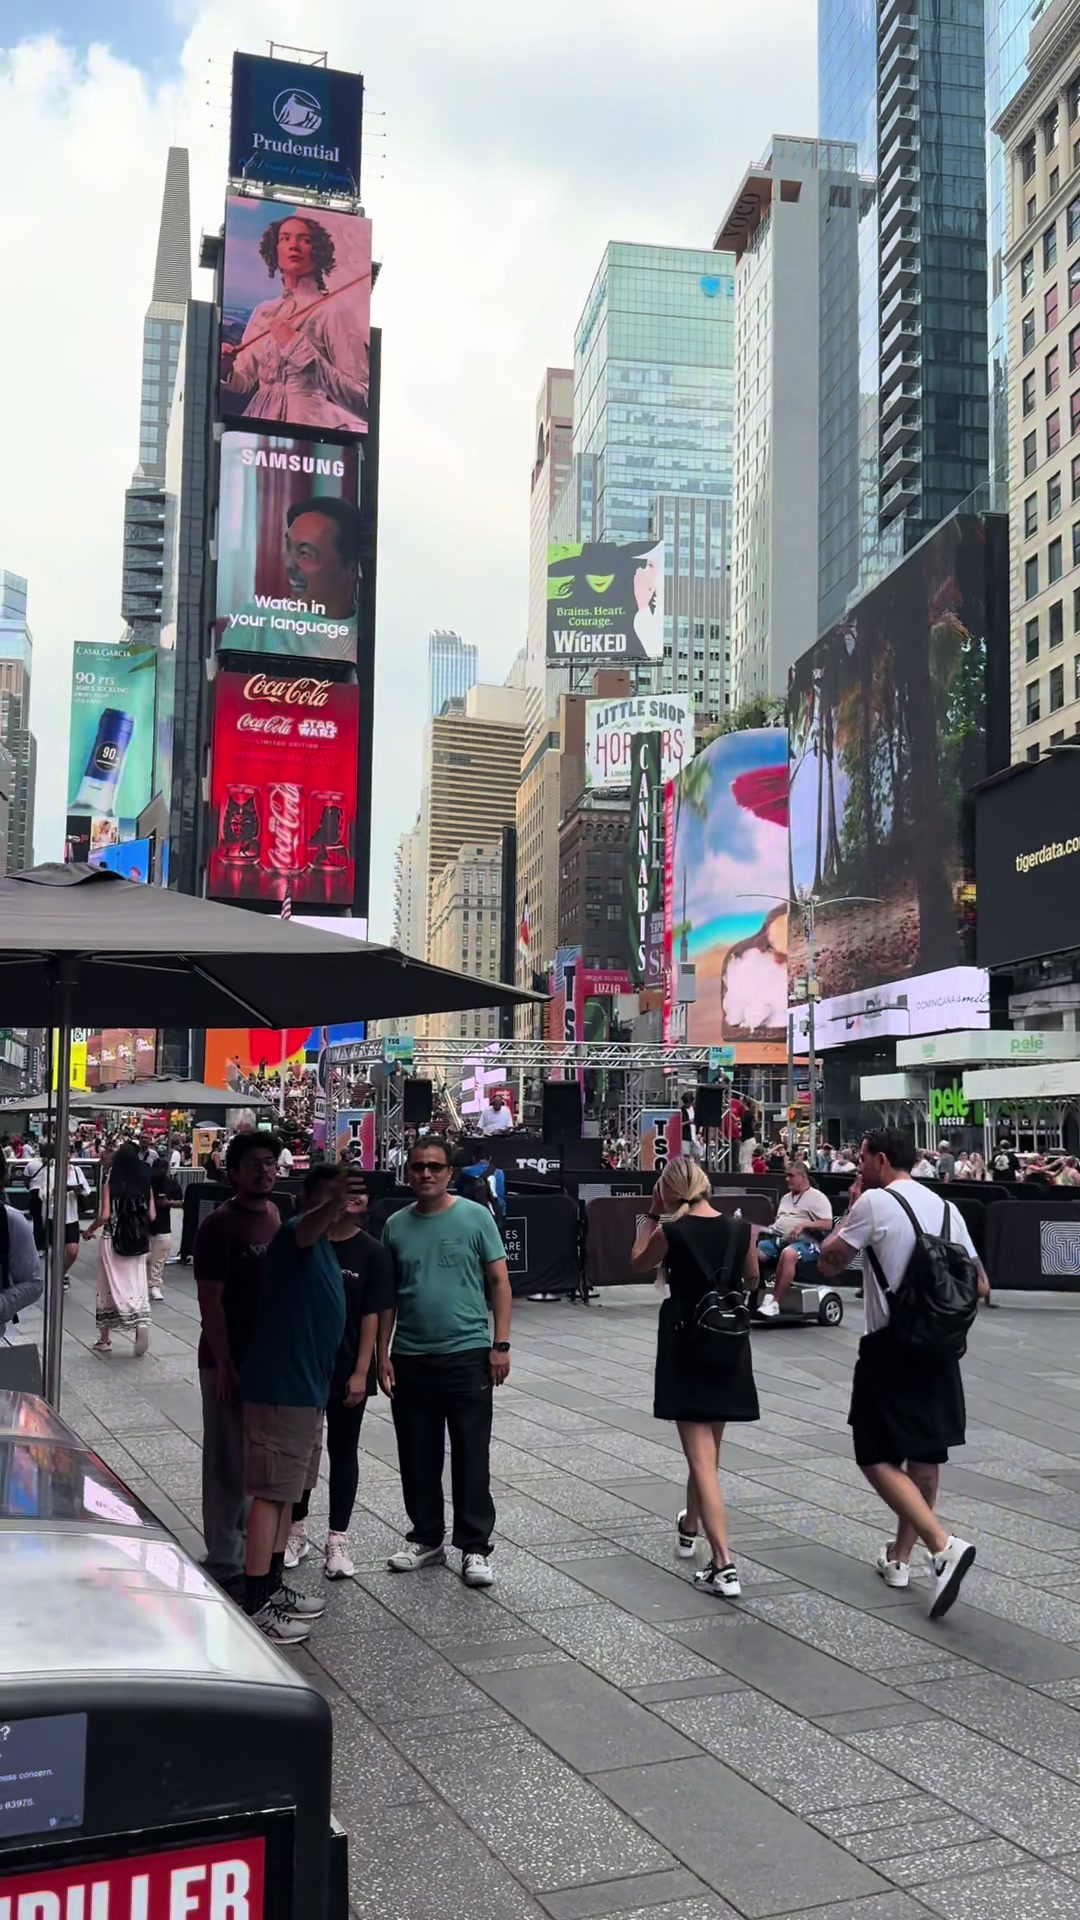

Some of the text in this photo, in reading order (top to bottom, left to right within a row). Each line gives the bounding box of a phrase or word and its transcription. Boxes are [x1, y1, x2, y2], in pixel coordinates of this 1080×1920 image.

[252, 133, 340, 162] Prudential
[241, 449, 345, 477] SAMSUNG
[254, 595, 326, 615] Watch in
[556, 606, 626, 616] Brains. Heart.
[229, 612, 349, 638] your language
[568, 616, 613, 627] Courage.
[75, 672, 95, 685] 90
[243, 673, 334, 707] Coca-Cola
[237, 713, 294, 735] Coca-Cola
[300, 719, 336, 729] STAR
[596, 700, 685, 730] LITTLE SHOP
[298, 727, 338, 739] WARS
[102, 747, 116, 760] 90
[596, 728, 684, 777] HORRS
[638, 744, 649, 971] CANNABIS
[1015, 836, 1080, 872] tigerdata.co
[516, 1158, 548, 1174] TSQ
